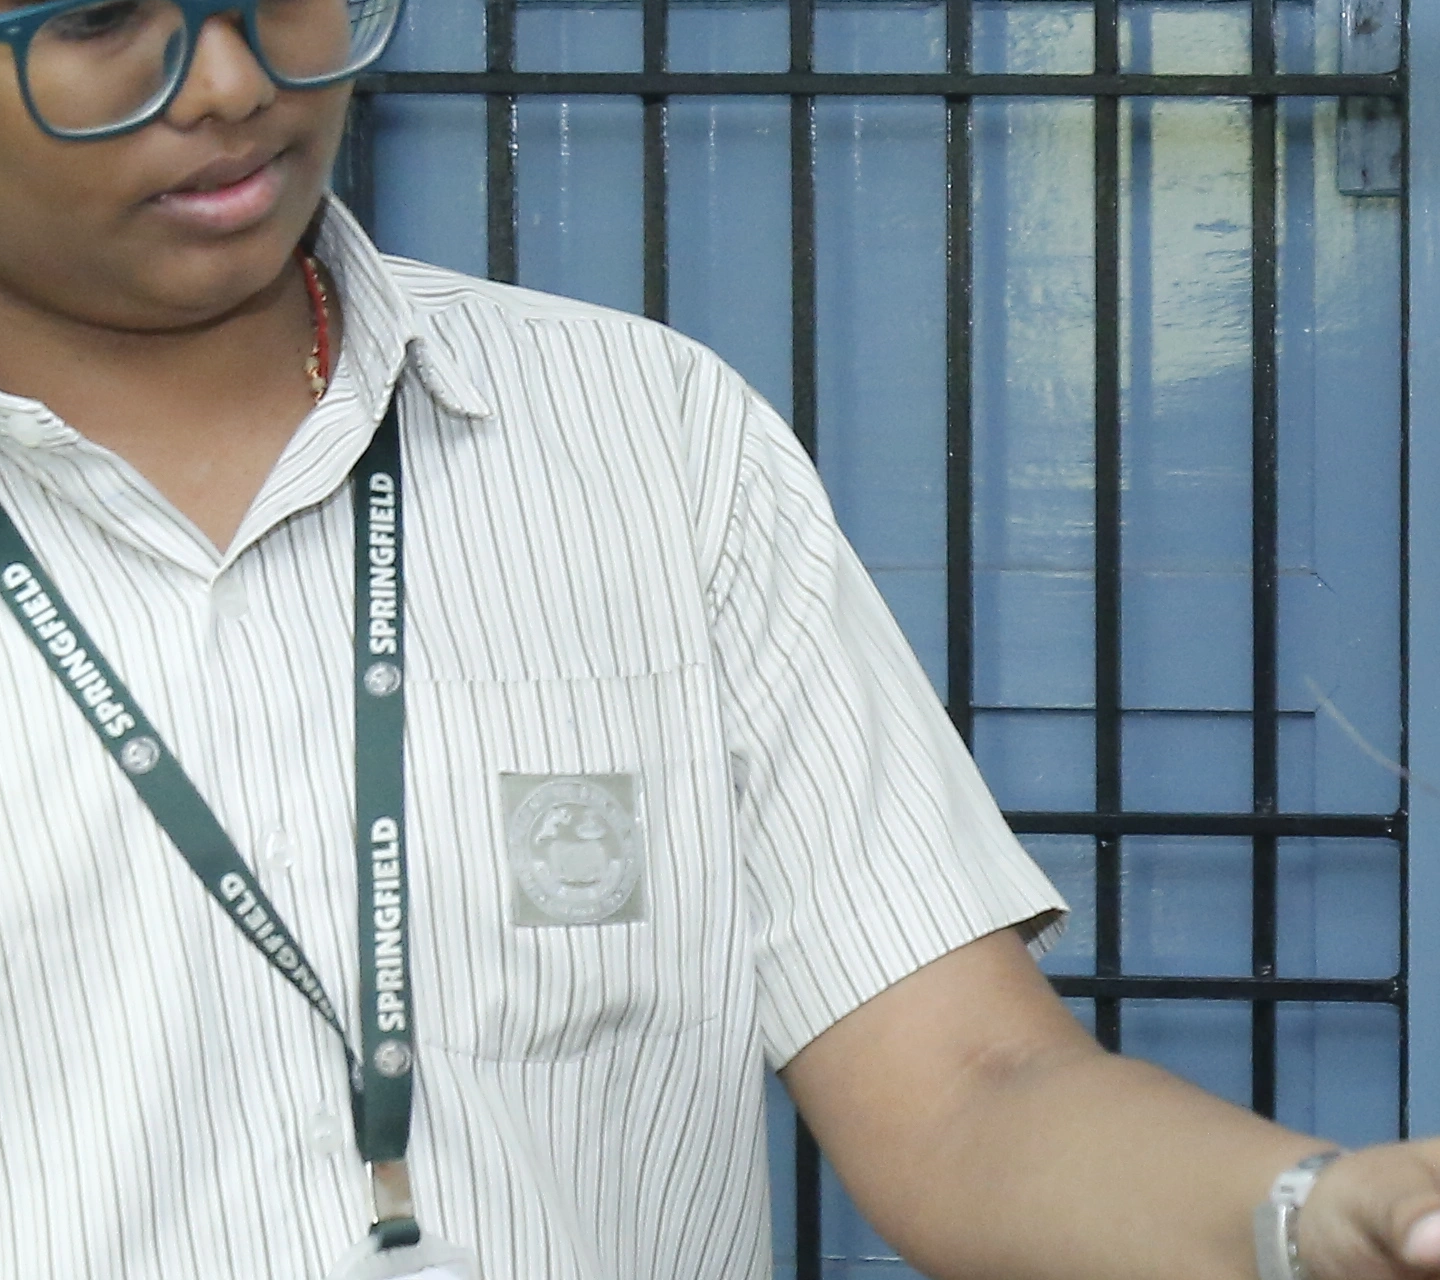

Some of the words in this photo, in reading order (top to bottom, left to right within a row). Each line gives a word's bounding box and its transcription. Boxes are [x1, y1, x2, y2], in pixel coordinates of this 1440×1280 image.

[2, 562, 136, 738] SPRINGFIELD
[370, 472, 395, 655] SPRINGFIELD
[220, 872, 335, 1020] RINGFIELD
[371, 817, 405, 1032] SPRINGFIELD
